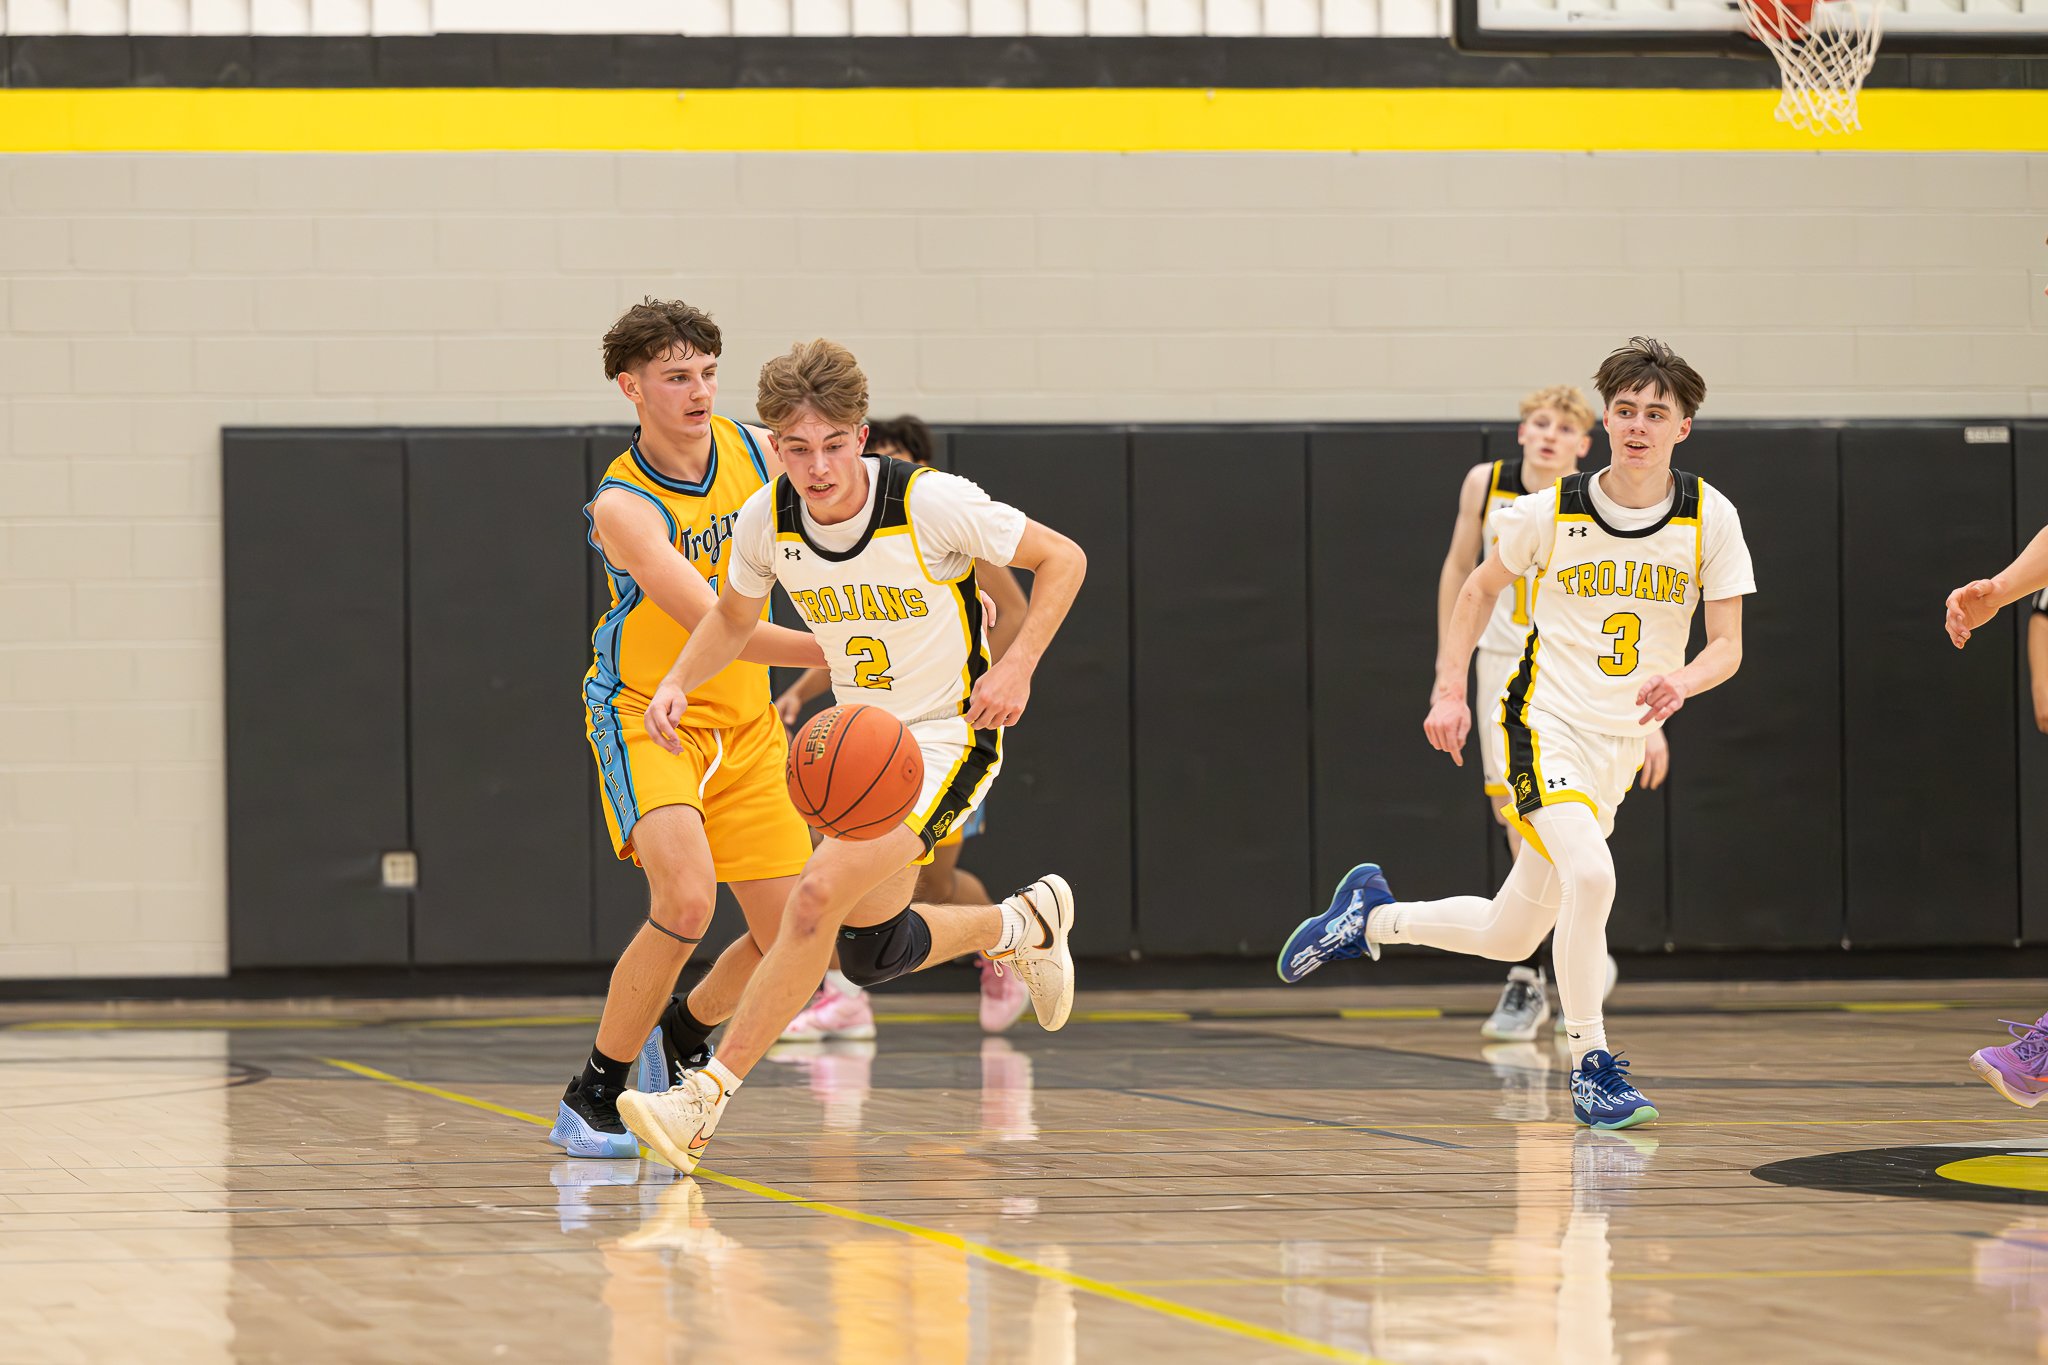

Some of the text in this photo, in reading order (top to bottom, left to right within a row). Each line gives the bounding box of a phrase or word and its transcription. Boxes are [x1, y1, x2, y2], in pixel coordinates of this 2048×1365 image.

[682, 510, 741, 566] Troja
[789, 584, 929, 624] TROJANS
[1557, 560, 1689, 605] TROJANS
[845, 636, 894, 691] 2
[1597, 612, 1641, 676] 3
